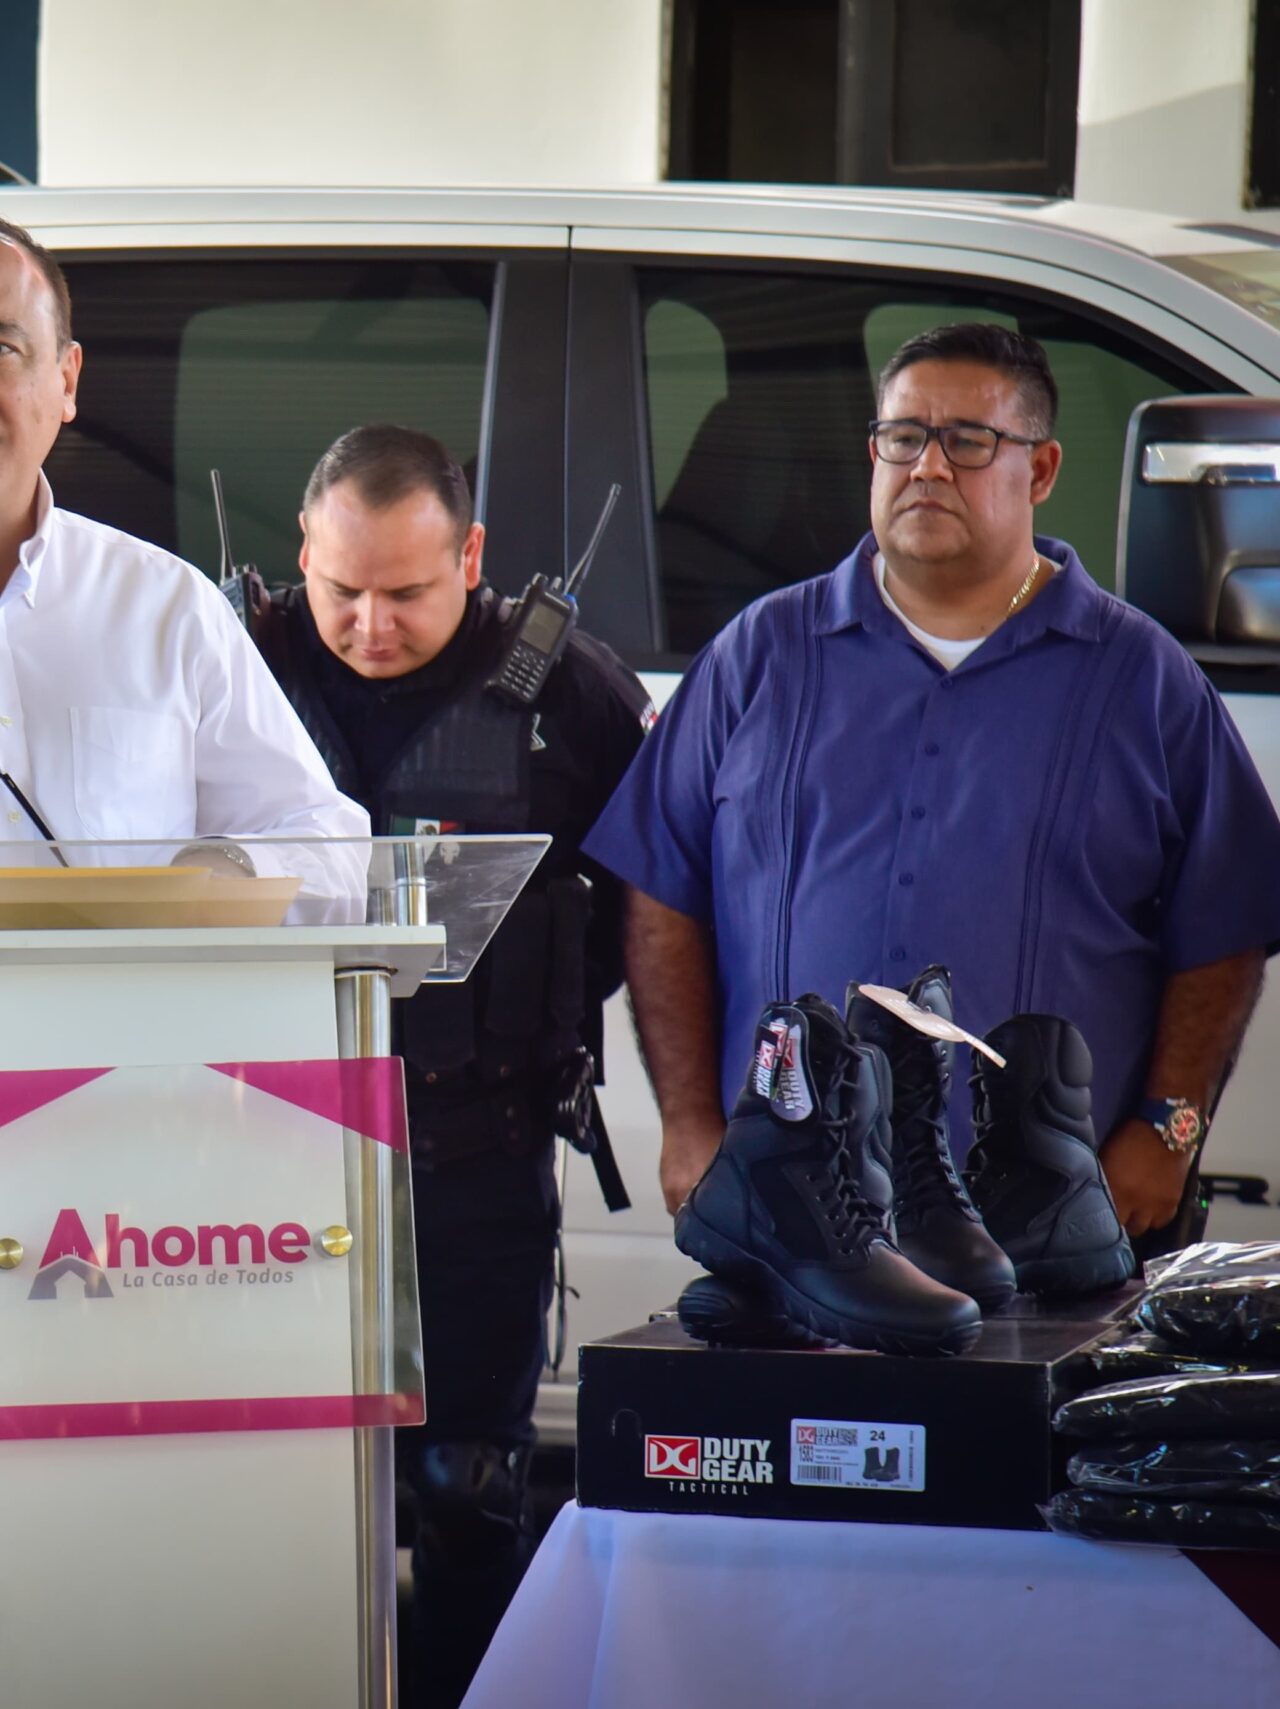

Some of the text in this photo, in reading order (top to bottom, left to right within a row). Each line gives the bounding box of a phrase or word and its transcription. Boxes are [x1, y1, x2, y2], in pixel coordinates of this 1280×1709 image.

[38, 1208, 311, 1269] Ahome
[122, 1268, 294, 1288] La Casa de Todos
[870, 1430, 885, 1441] 24
[703, 1437, 771, 1461] DUTY
[702, 1459, 773, 1483] GEAR
[669, 1481, 748, 1495] TACTICAL
